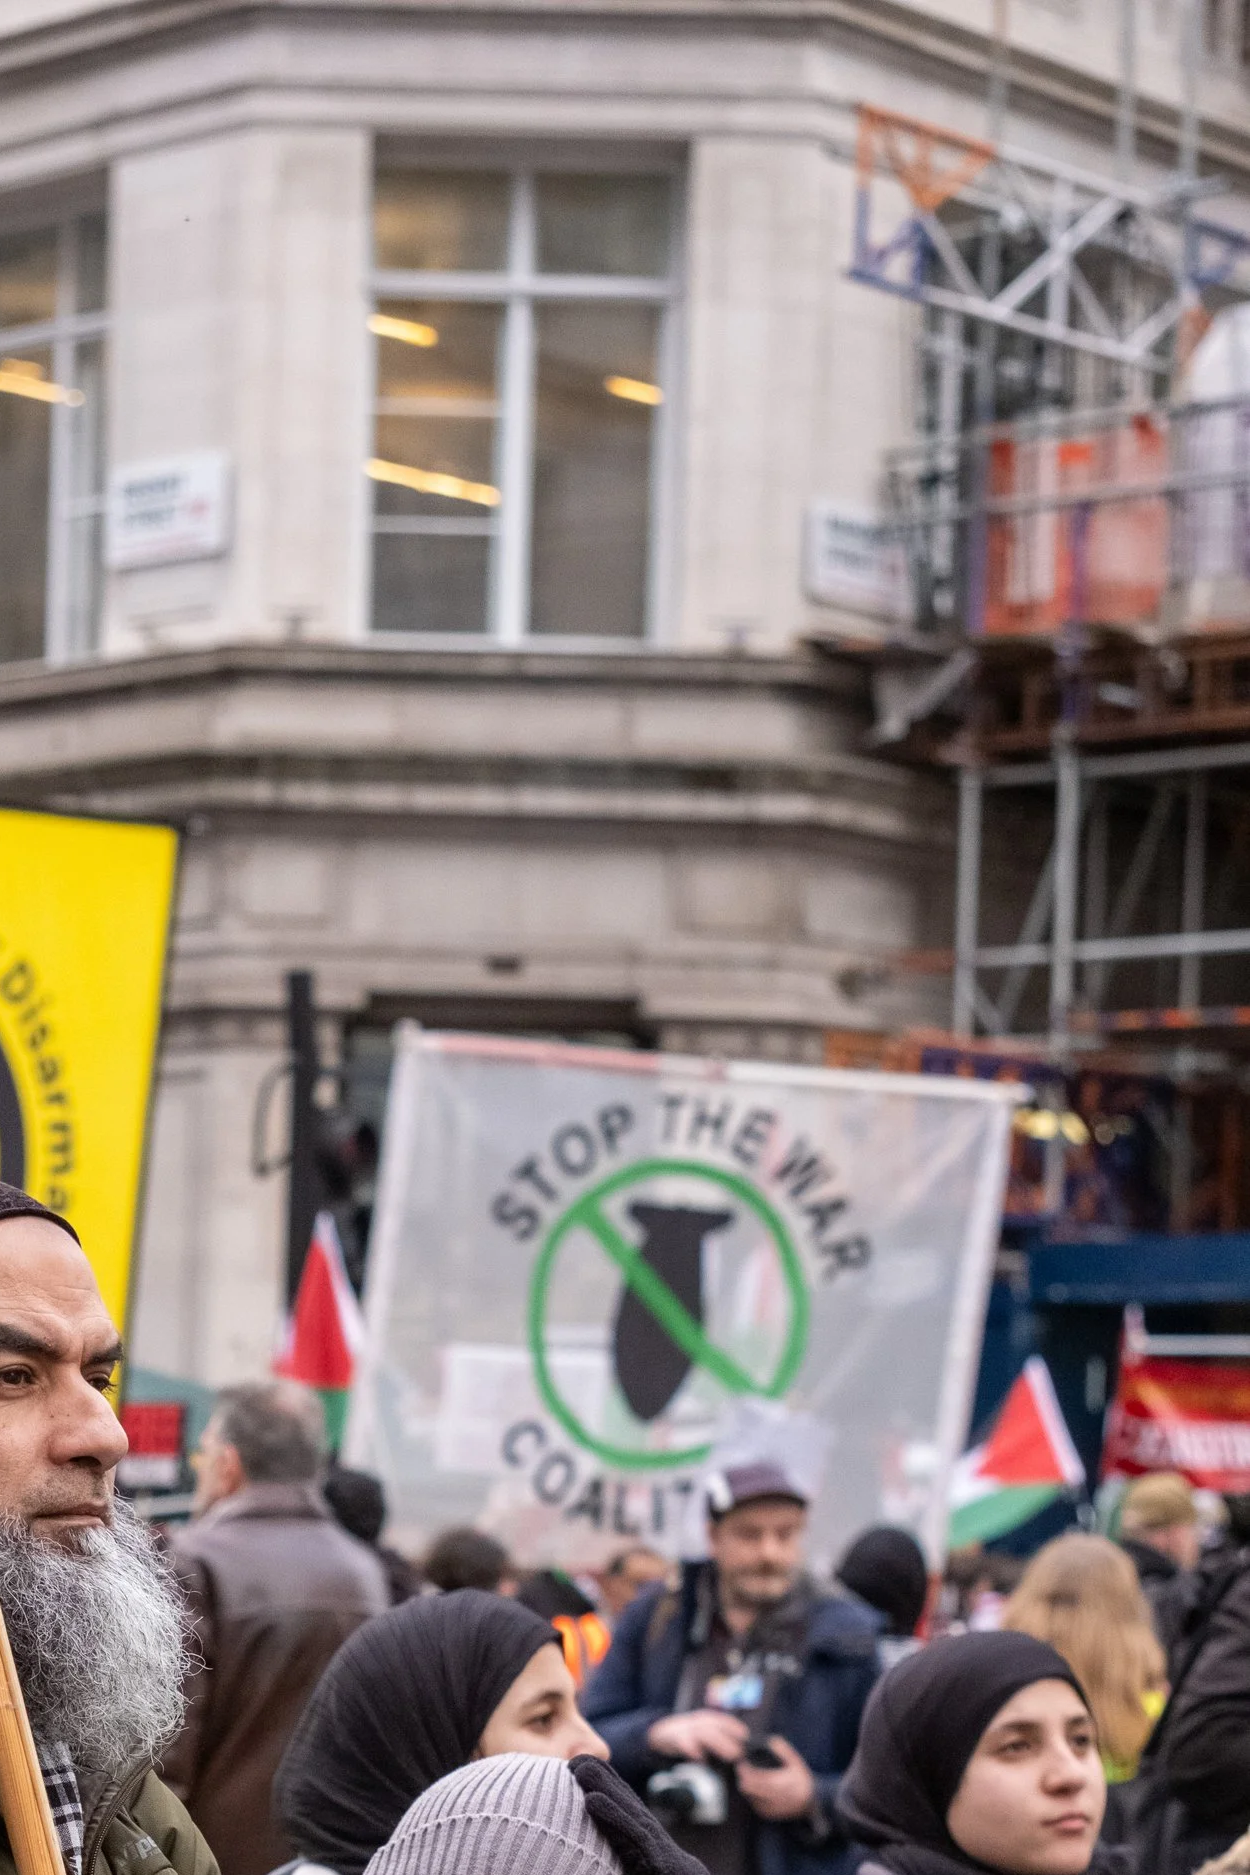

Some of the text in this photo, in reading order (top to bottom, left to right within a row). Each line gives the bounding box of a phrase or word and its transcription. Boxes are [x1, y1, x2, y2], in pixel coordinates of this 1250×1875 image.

[489, 1092, 872, 1280] STOP THE WAR
